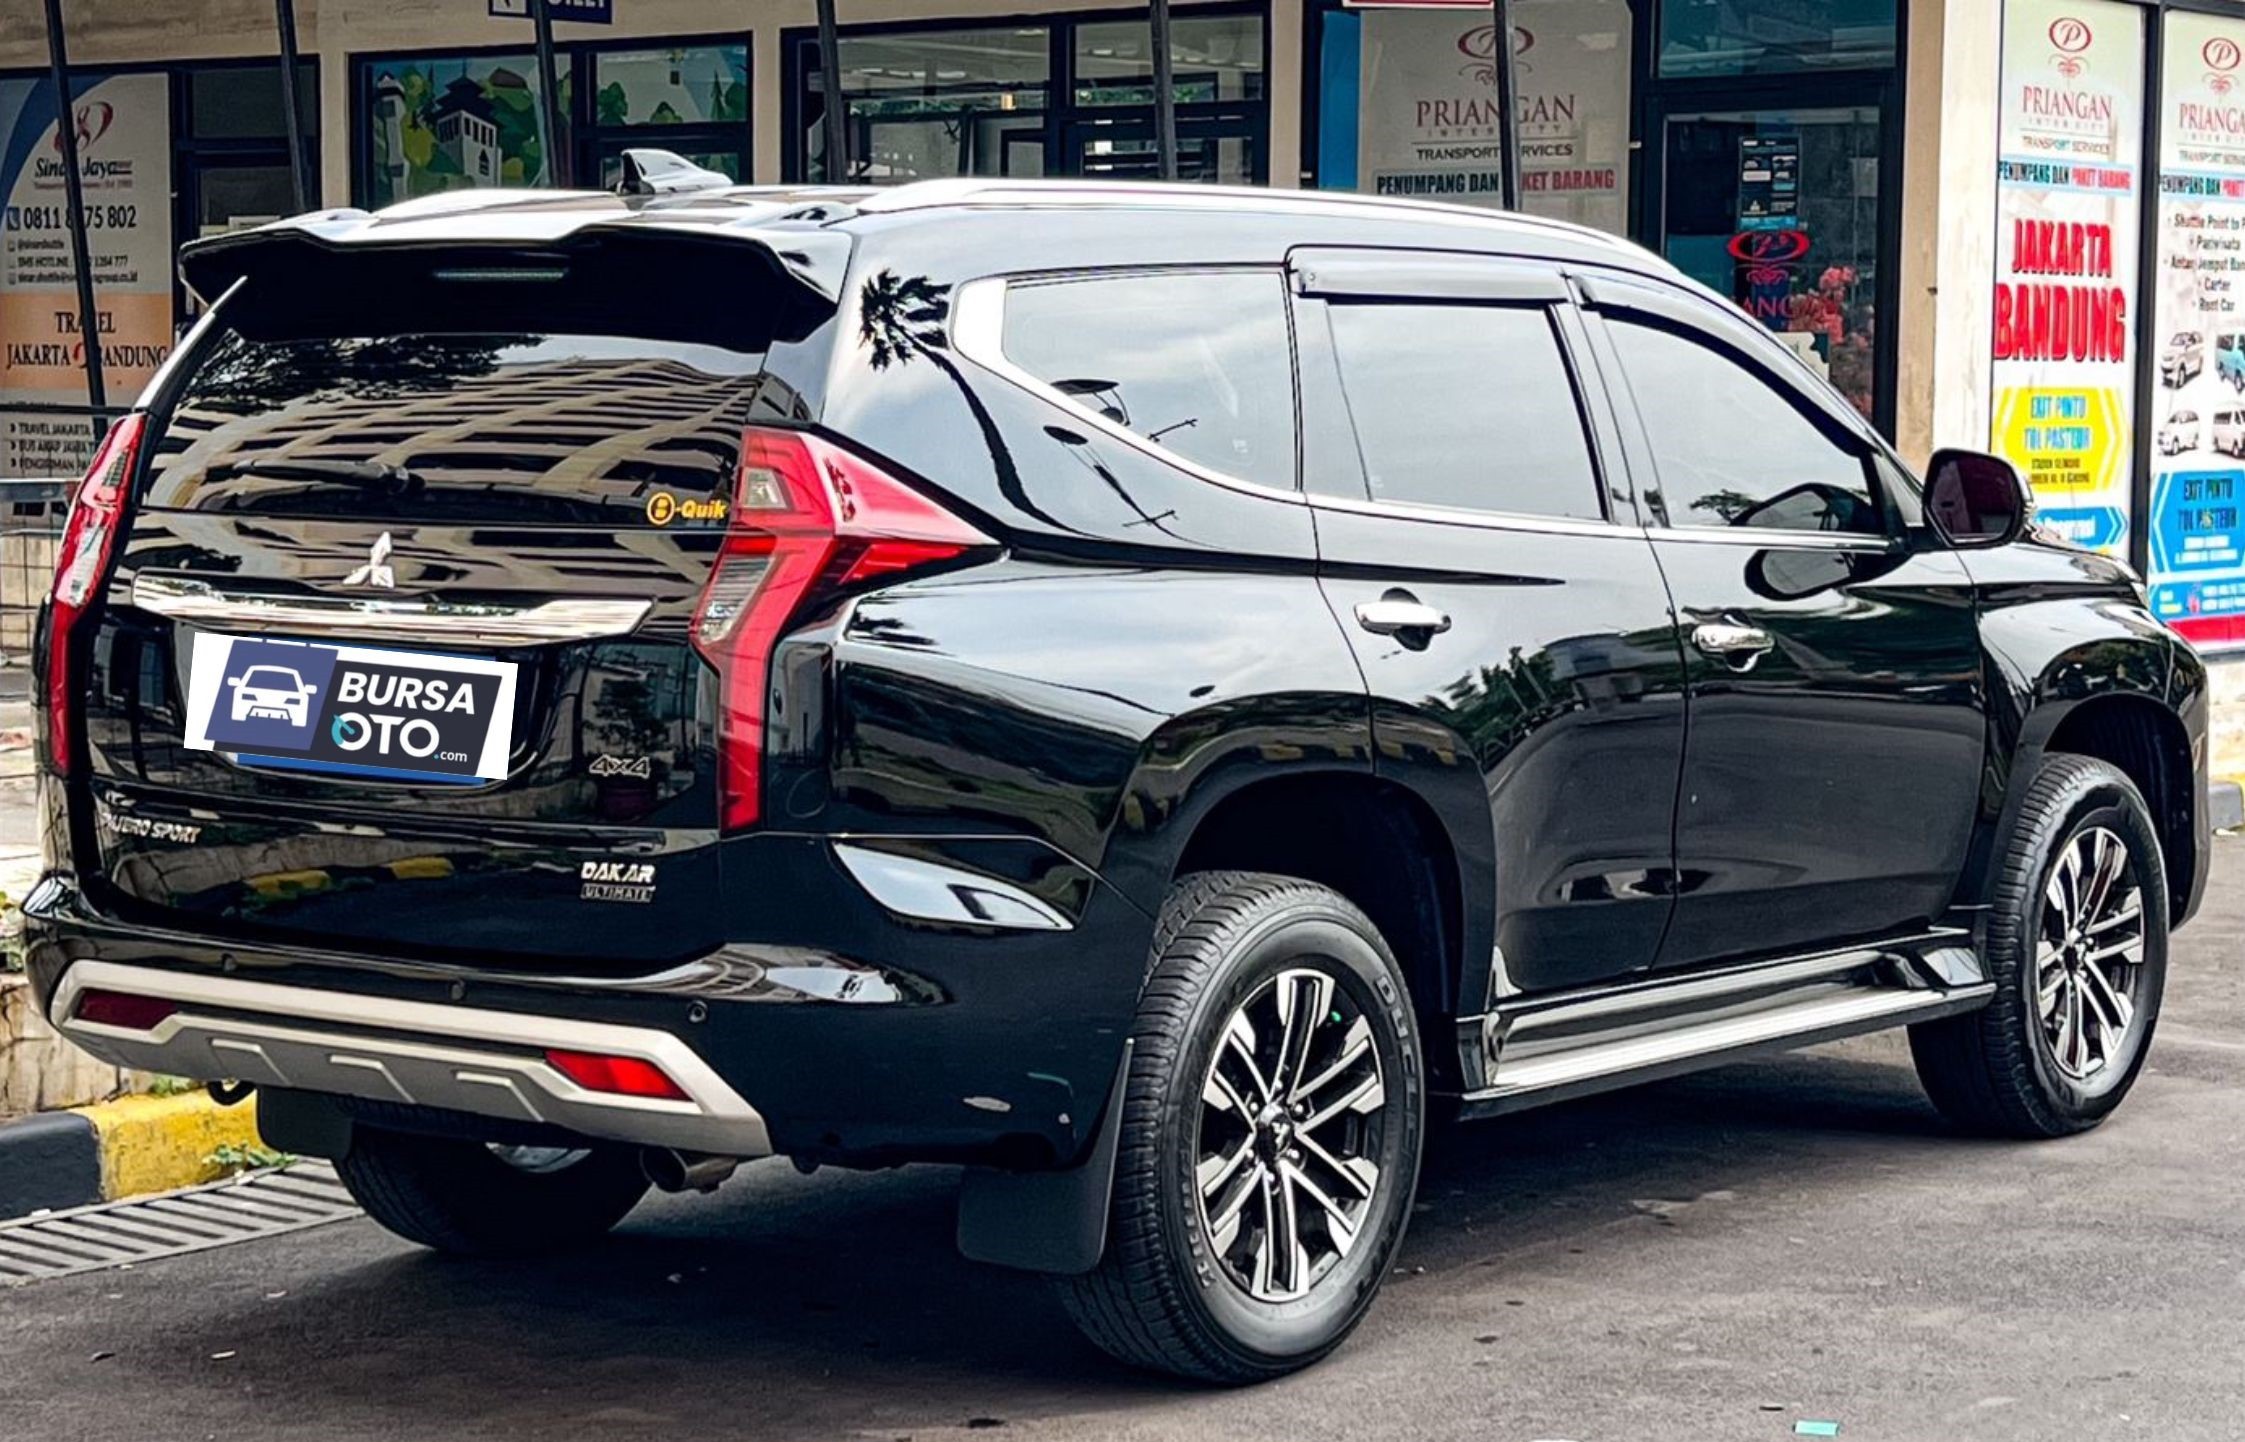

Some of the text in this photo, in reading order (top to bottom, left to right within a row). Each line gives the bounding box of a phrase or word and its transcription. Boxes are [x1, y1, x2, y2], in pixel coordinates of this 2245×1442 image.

[2022, 86, 2112, 121] PRIANGAN
[1520, 144, 1573, 157] RVICES
[1376, 168, 1615, 195] PENUMPANG DAN KET BARANG
[2052, 165, 2068, 185] DAN
[23, 205, 61, 230] 0811
[107, 205, 137, 228] 802
[2012, 218, 2112, 278] JAKARTA
[1993, 283, 2127, 363] BANDUNG
[6, 343, 71, 370] JAKARTA
[150, 822, 202, 843] SPORT
[580, 861, 656, 883] DAKAR
[582, 884, 655, 901] ULTIMATE
